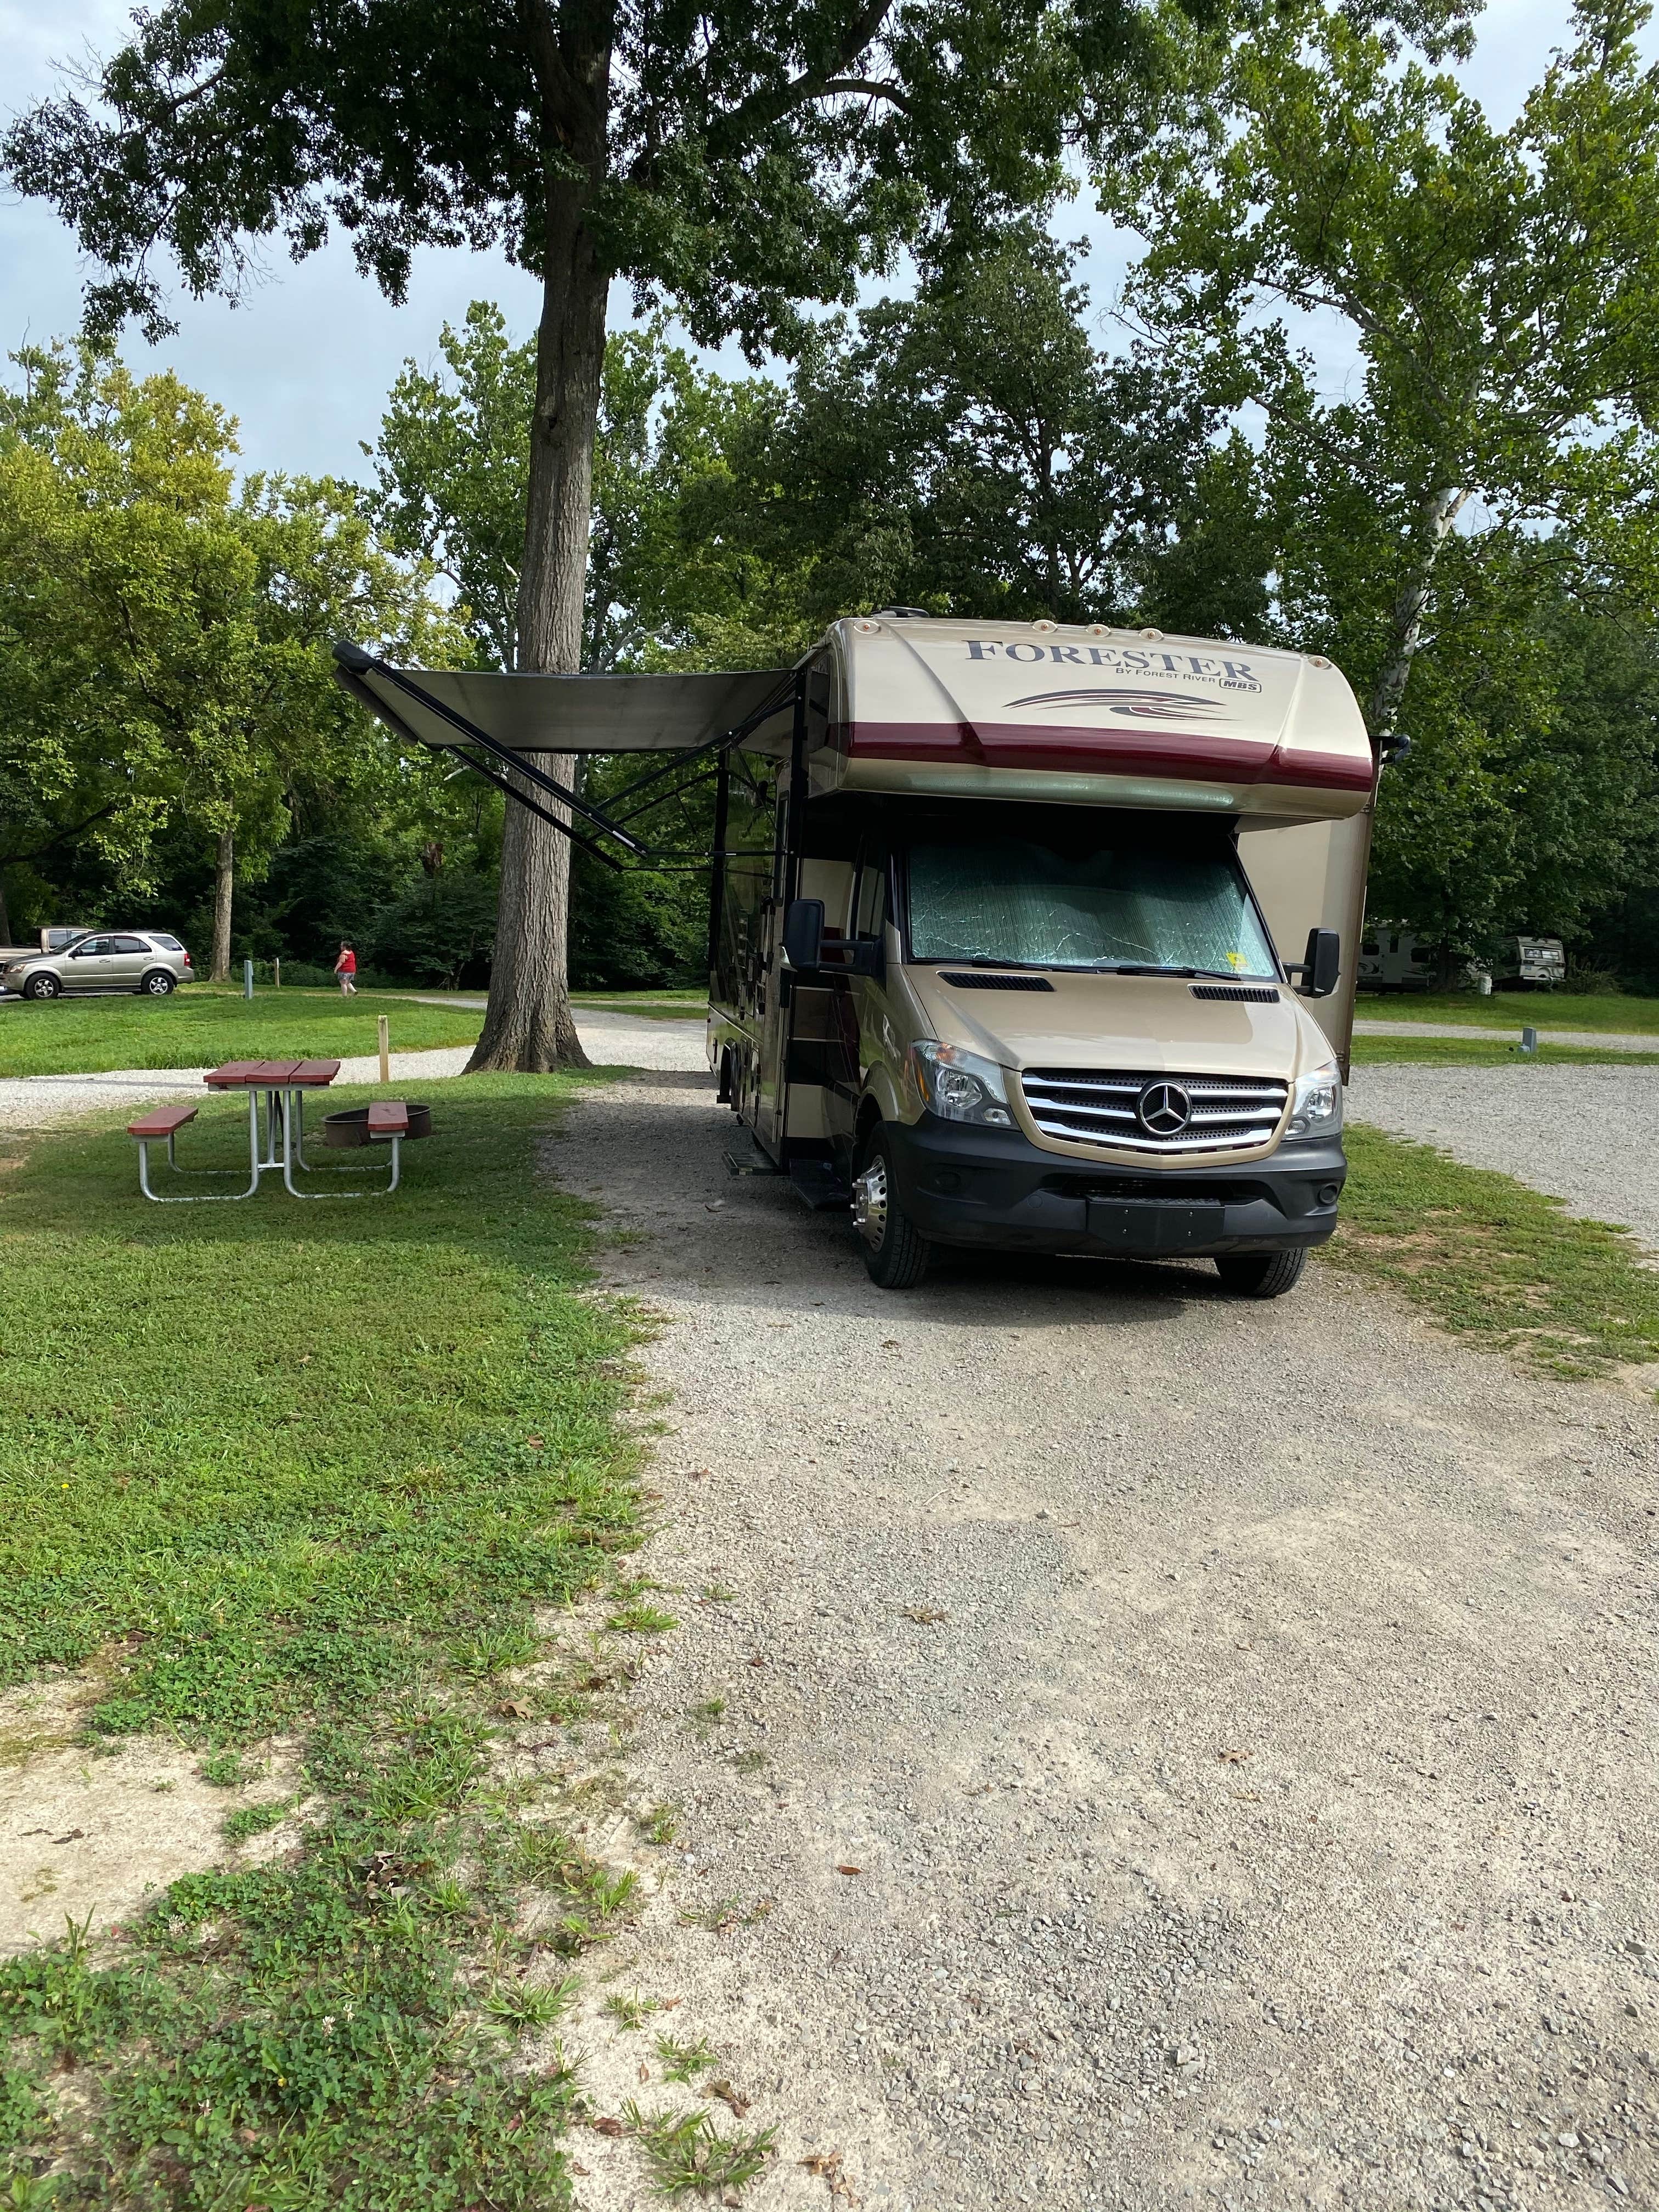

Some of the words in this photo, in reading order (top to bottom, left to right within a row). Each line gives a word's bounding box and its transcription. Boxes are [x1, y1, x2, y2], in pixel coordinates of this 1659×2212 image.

[961, 640, 1260, 682] FORESTER
[1136, 669, 1180, 679] FOREST
[1183, 674, 1215, 683] RIVER
[1223, 680, 1258, 691] MBS
